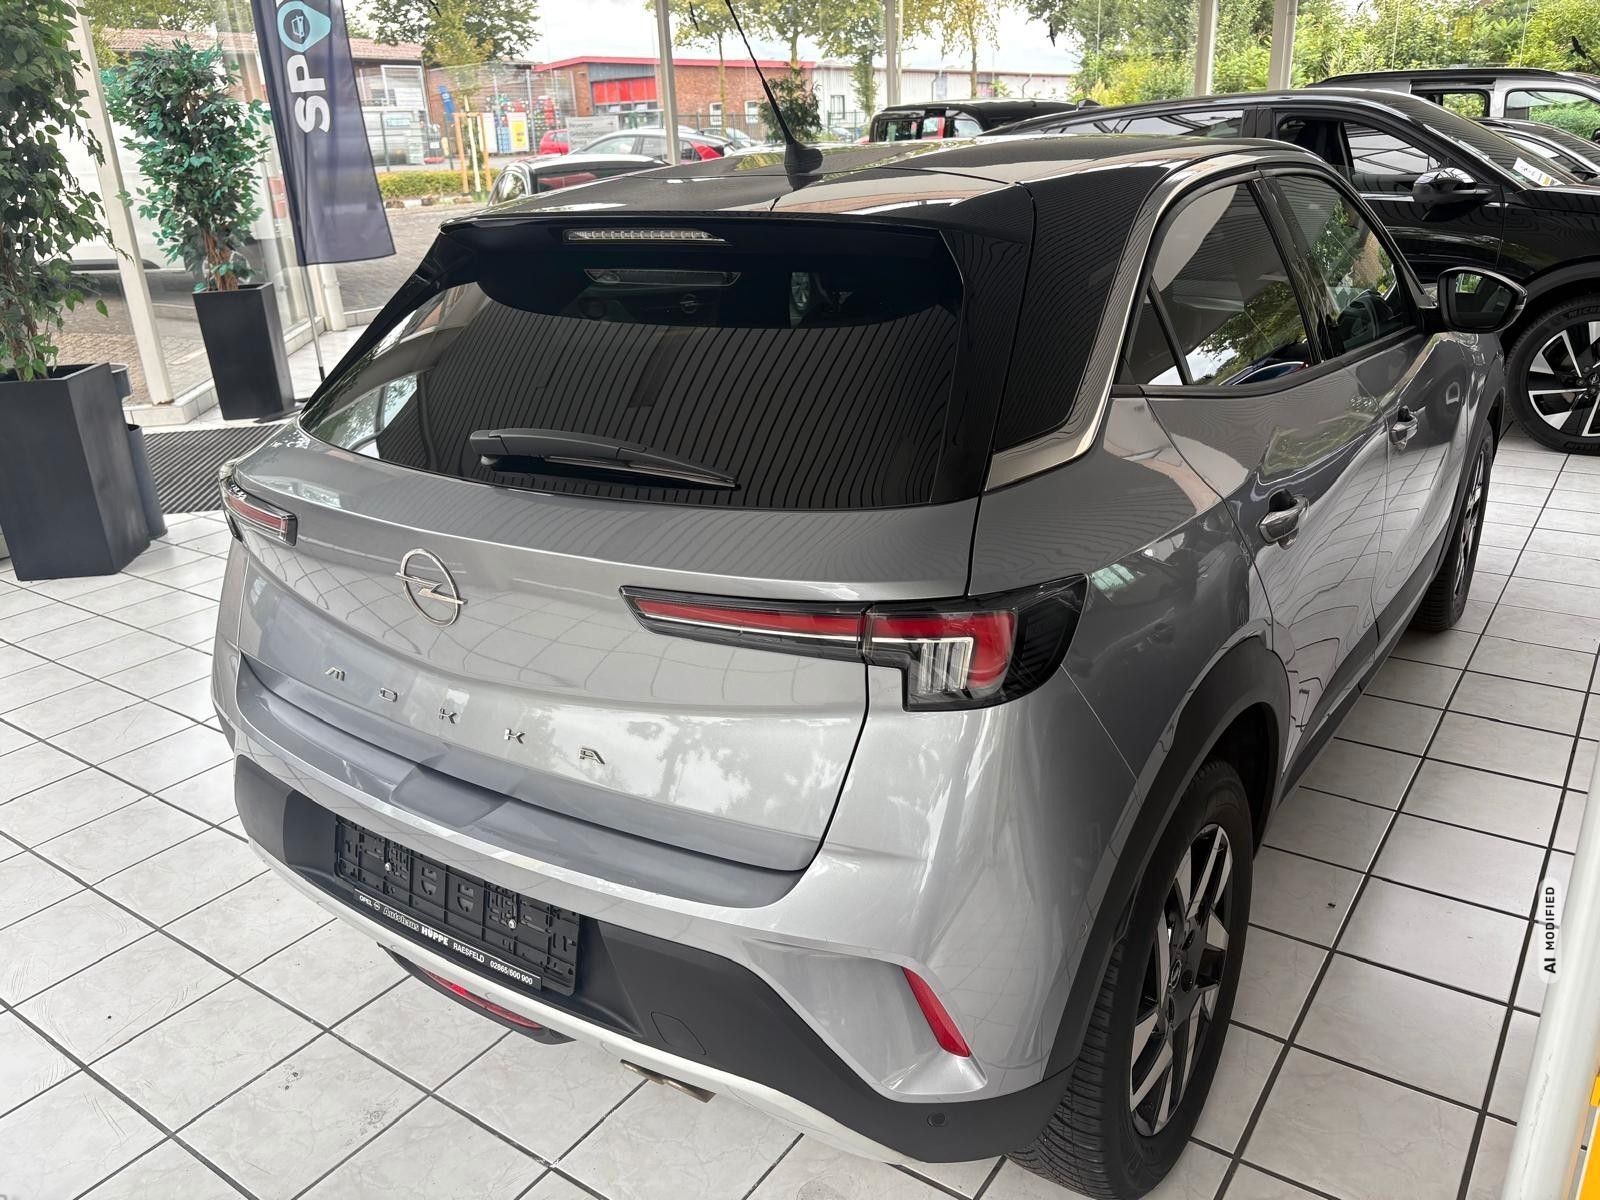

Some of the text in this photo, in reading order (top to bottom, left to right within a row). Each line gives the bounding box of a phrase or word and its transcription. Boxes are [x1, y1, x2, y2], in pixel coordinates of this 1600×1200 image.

[325, 666, 605, 765] MOKKA
[421, 926, 449, 946] HÜPPE
[453, 942, 485, 963] RAESFELD
[521, 974, 533, 985] 900
